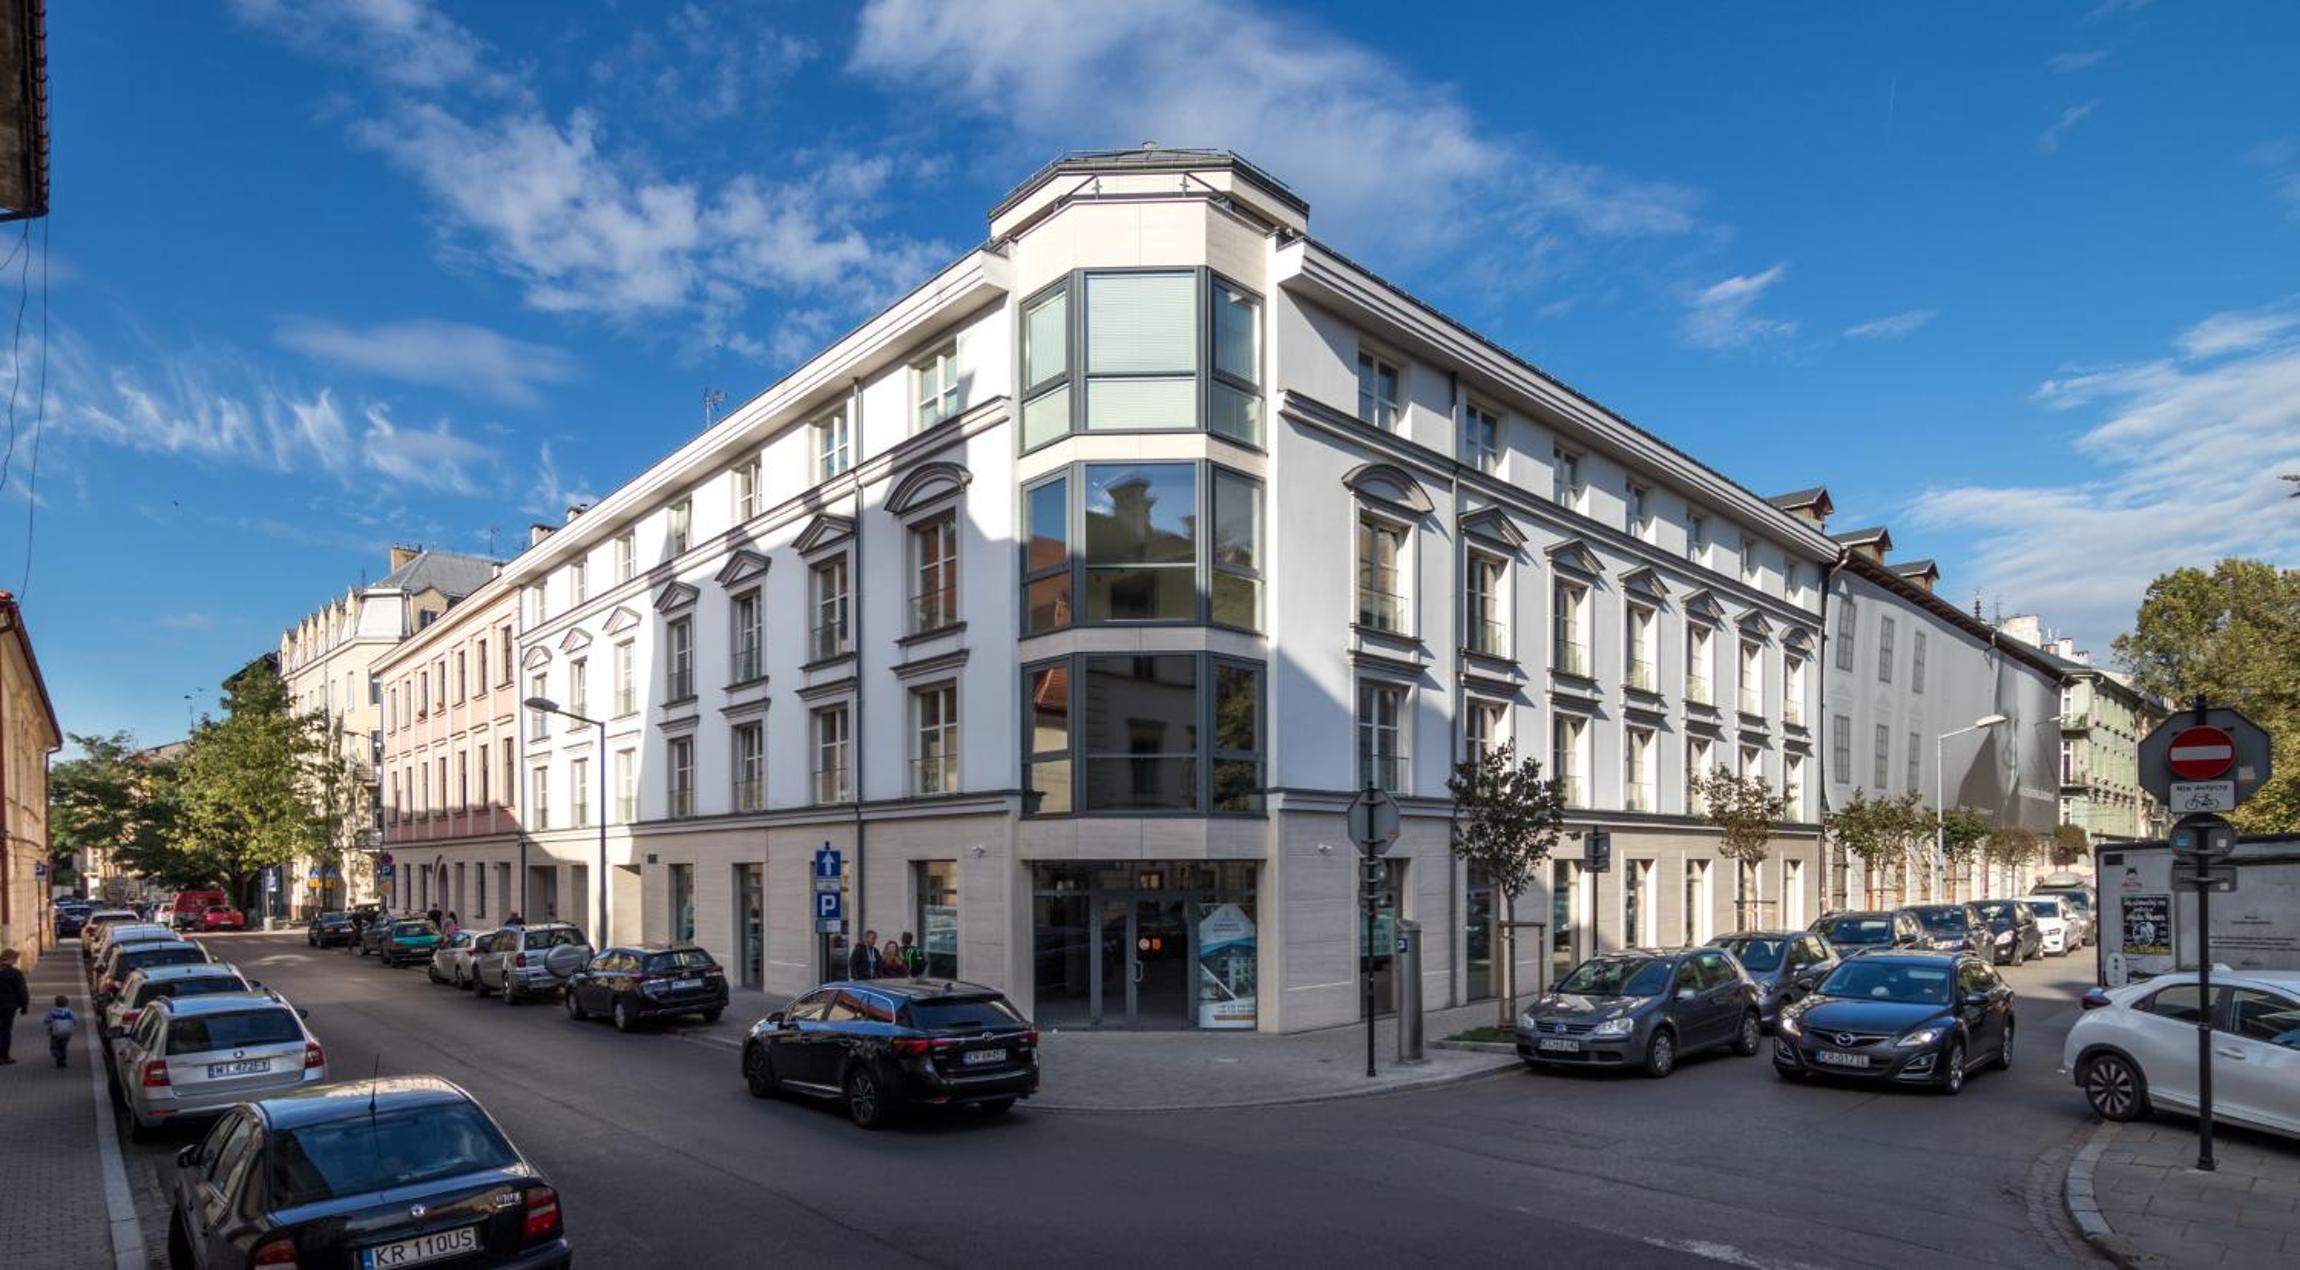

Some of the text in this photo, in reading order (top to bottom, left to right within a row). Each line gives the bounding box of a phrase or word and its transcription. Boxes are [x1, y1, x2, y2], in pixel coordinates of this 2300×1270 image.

[2176, 783, 2229, 793] Nie dotyczy
[821, 895, 836, 916] P
[375, 1228, 474, 1267] KR 110US
